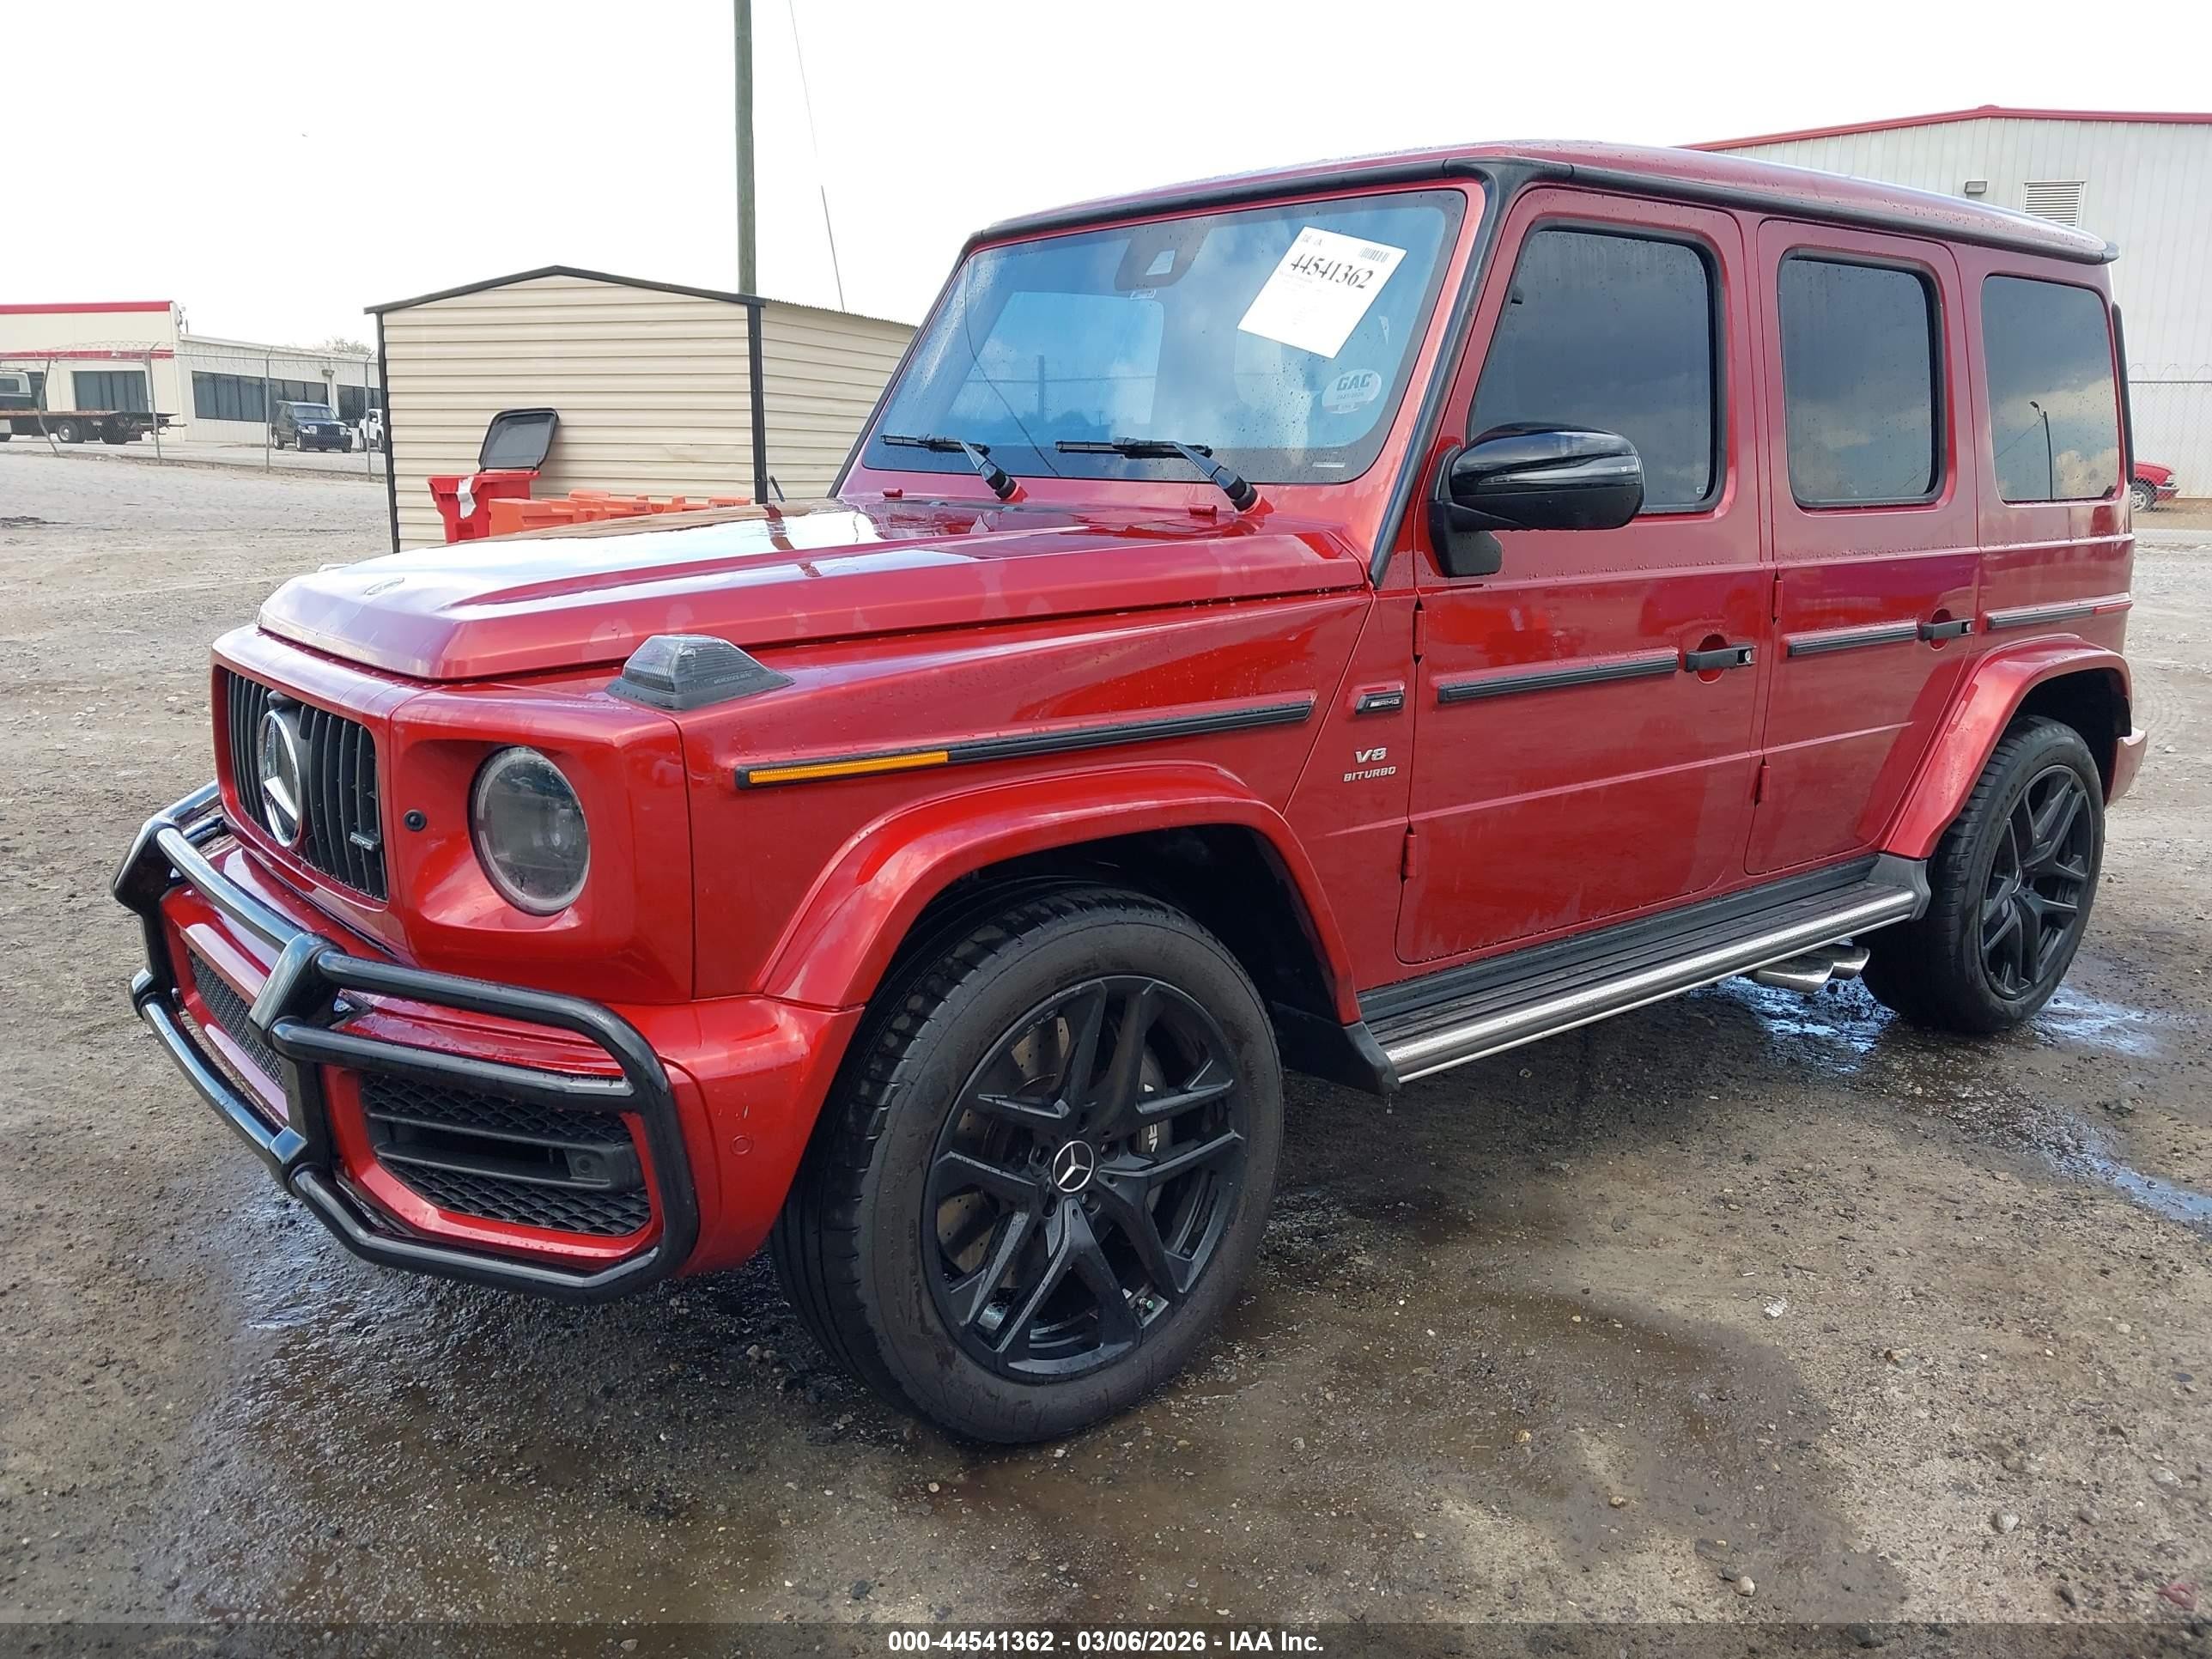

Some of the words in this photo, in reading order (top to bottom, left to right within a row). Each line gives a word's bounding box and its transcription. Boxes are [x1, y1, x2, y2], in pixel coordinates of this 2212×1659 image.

[1291, 253, 1374, 289] 44541362
[1337, 373, 1372, 391] GAC
[1355, 747, 1387, 763] V8
[1343, 766, 1396, 782] BITURBO
